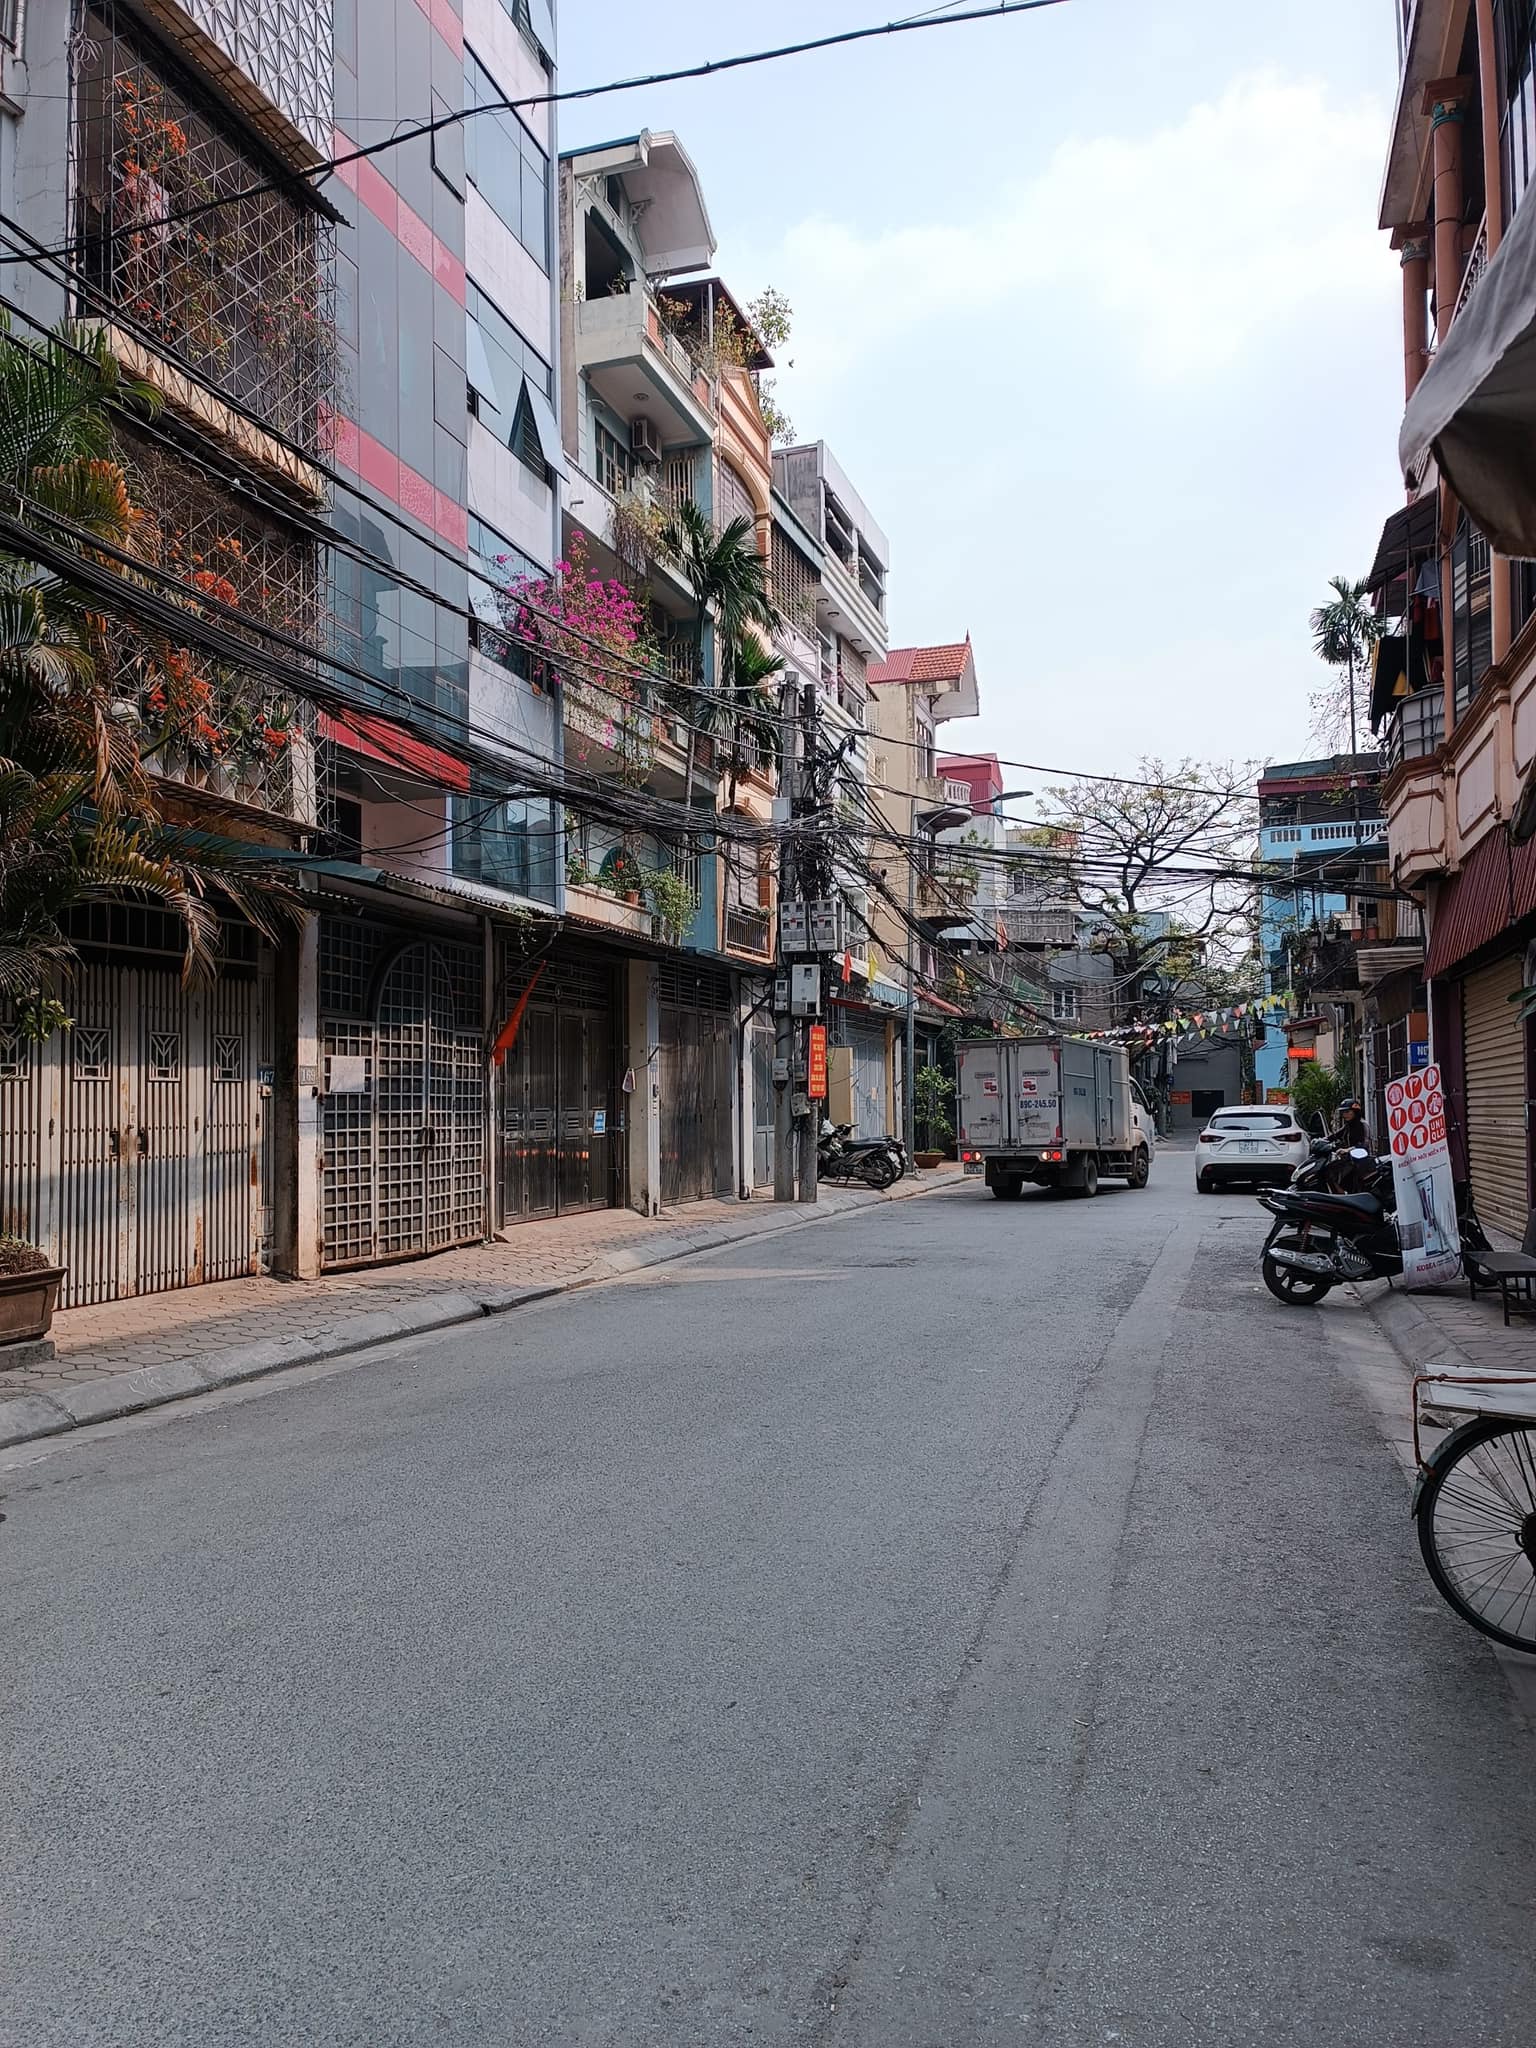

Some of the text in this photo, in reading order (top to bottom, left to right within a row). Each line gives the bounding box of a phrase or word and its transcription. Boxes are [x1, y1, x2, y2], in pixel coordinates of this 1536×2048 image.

[260, 1071, 274, 1084] 167
[302, 1069, 316, 1082] 169
[1020, 1099, 1057, 1109] 89C-245.50
[1430, 1117, 1443, 1130] UNI
[1431, 1129, 1444, 1140] QLO
